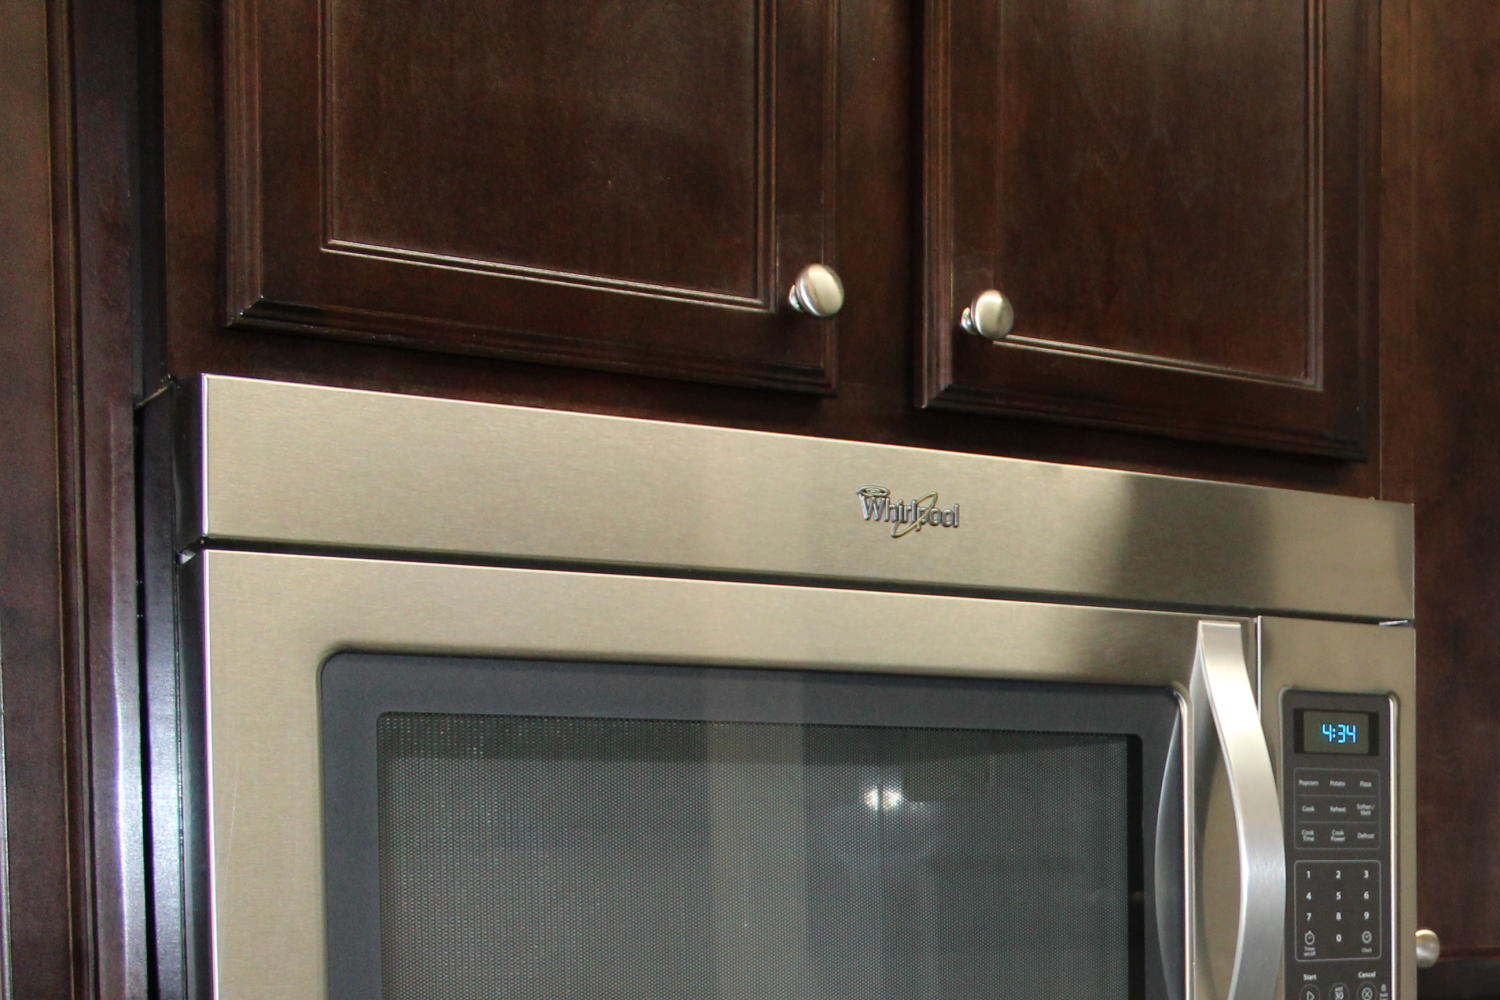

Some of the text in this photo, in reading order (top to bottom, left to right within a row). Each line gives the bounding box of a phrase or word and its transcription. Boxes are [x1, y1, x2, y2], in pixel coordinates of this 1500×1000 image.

[855, 484, 960, 538] Whirlpool
[1320, 723, 1357, 744] 4:34
[1306, 870, 1311, 879] 1
[1335, 870, 1342, 879] 2
[1363, 870, 1369, 879] 3
[1305, 891, 1312, 900] 4
[1335, 891, 1342, 900] 5
[1363, 891, 1370, 900] 6
[1306, 912, 1312, 921] 7
[1335, 912, 1342, 921] 8
[1363, 912, 1370, 920] 9
[1335, 934, 1342, 942] 0
[1303, 973, 1317, 981] Start
[1357, 971, 1376, 979] Cancel
